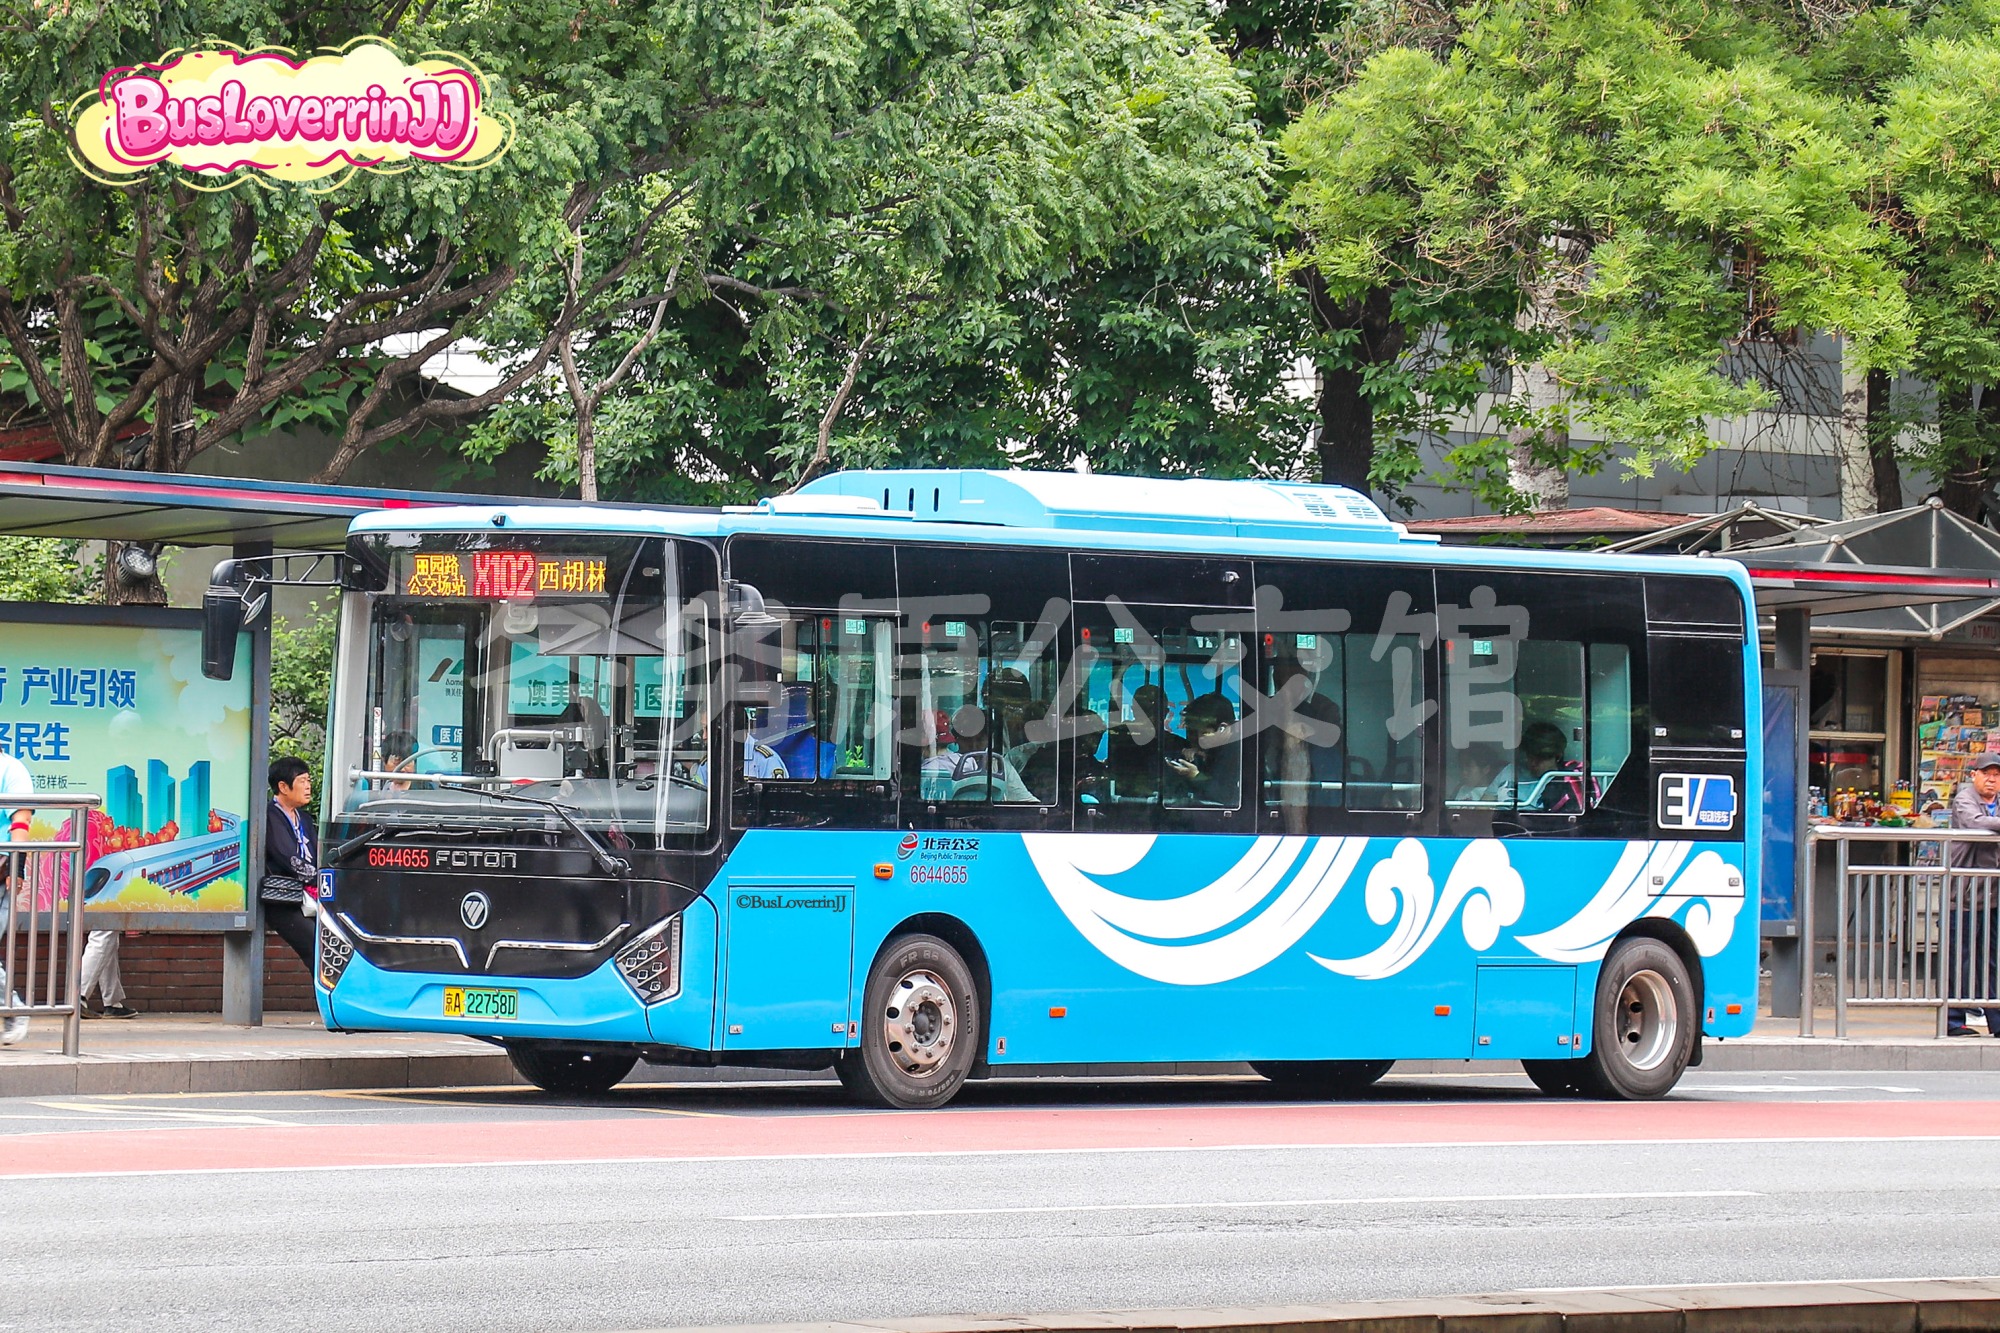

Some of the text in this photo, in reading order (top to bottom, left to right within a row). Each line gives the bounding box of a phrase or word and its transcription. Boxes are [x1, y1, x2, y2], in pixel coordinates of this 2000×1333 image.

[414, 554, 460, 576] 丽园路
[475, 554, 535, 596] X102
[407, 575, 467, 597] 公交场站
[538, 561, 607, 592] 西胡林
[21, 667, 136, 708] 产业引领
[922, 837, 981, 851] 北京公交
[368, 848, 518, 869] 6644655 FOTON
[920, 853, 938, 861] Beijing
[954, 853, 978, 861] Transport
[910, 865, 967, 883] 6644655
